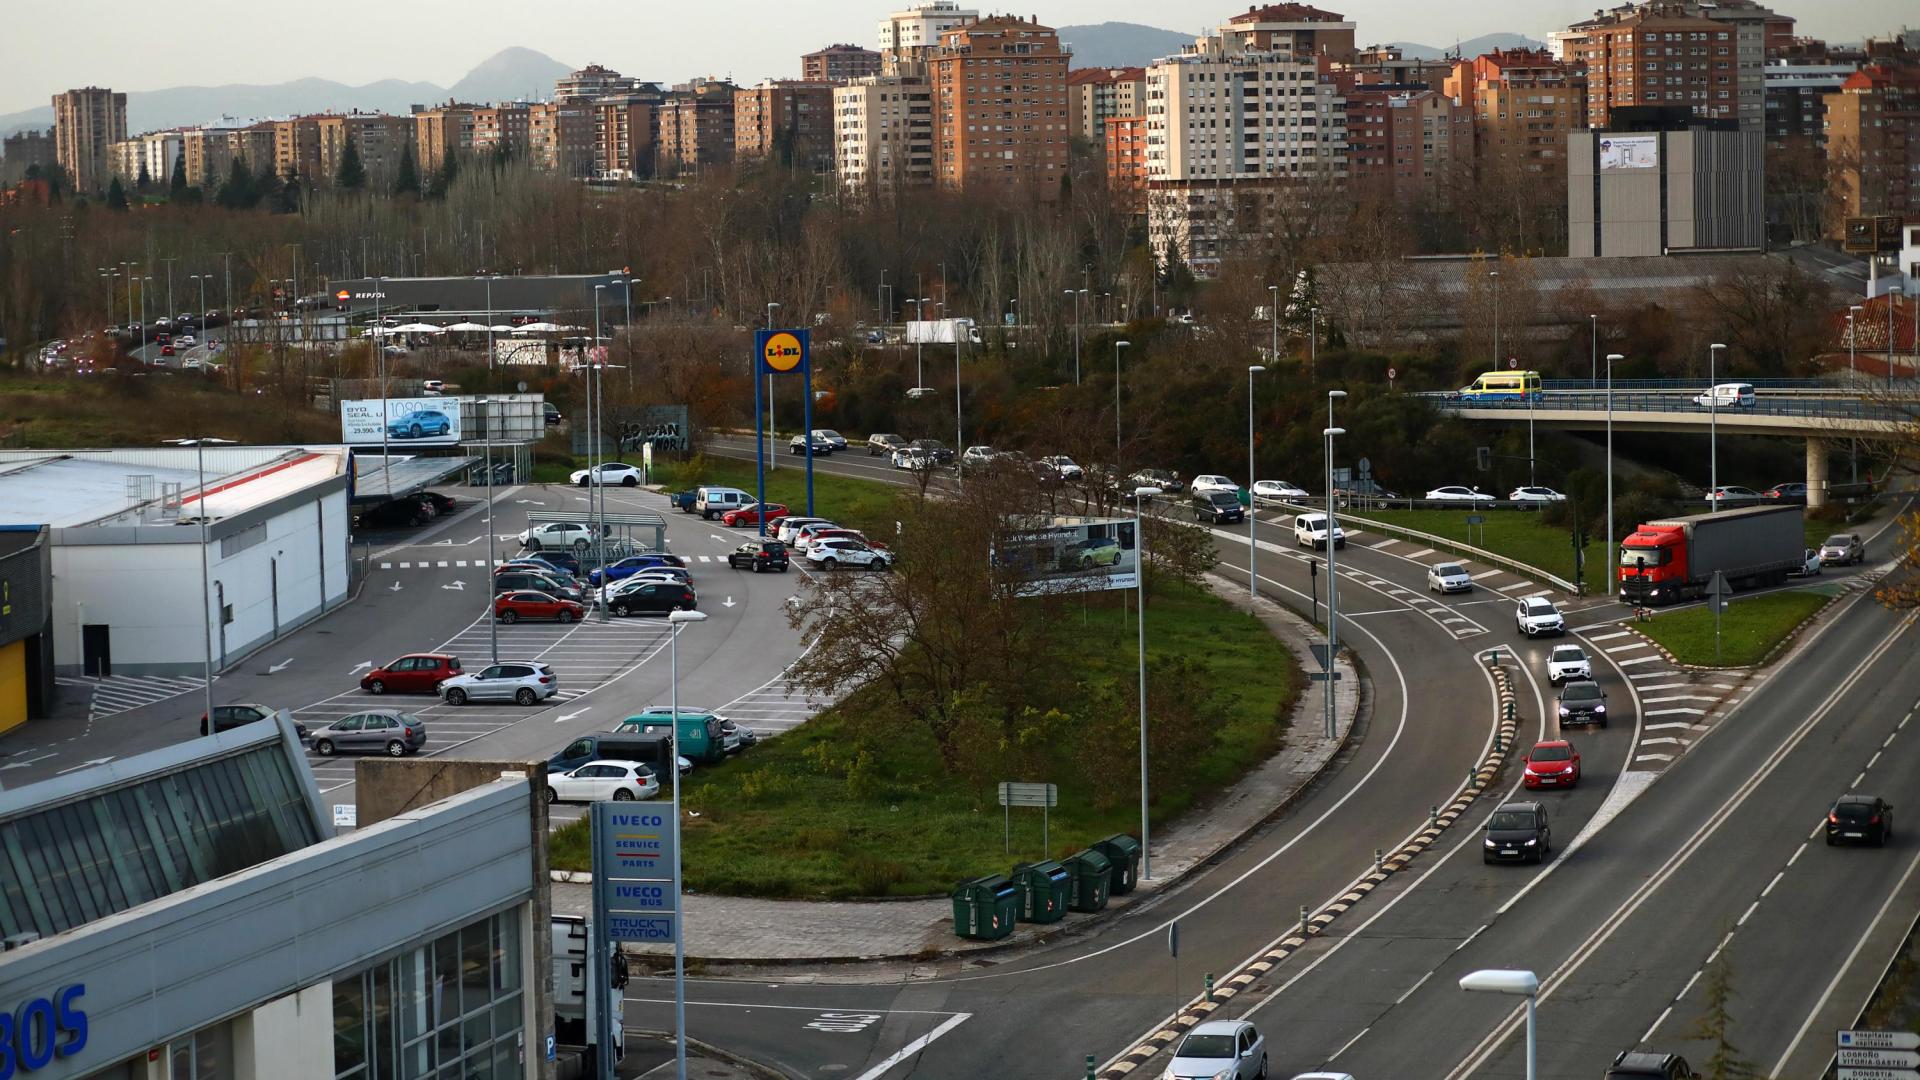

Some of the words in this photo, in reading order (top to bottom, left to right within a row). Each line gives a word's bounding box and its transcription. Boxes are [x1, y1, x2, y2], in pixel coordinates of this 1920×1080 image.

[612, 815, 662, 826] IVECO
[615, 840, 660, 848] SERVICE
[622, 860, 655, 868] PARTS
[616, 886, 662, 897] IVECO
[640, 898, 662, 906] BUS
[610, 919, 655, 928] TRUCK
[610, 928, 670, 938] STATION
[1842, 1051, 1879, 1059] LOGROÑO
[1842, 1059, 1908, 1067] VITORIA-GASTEIZ
